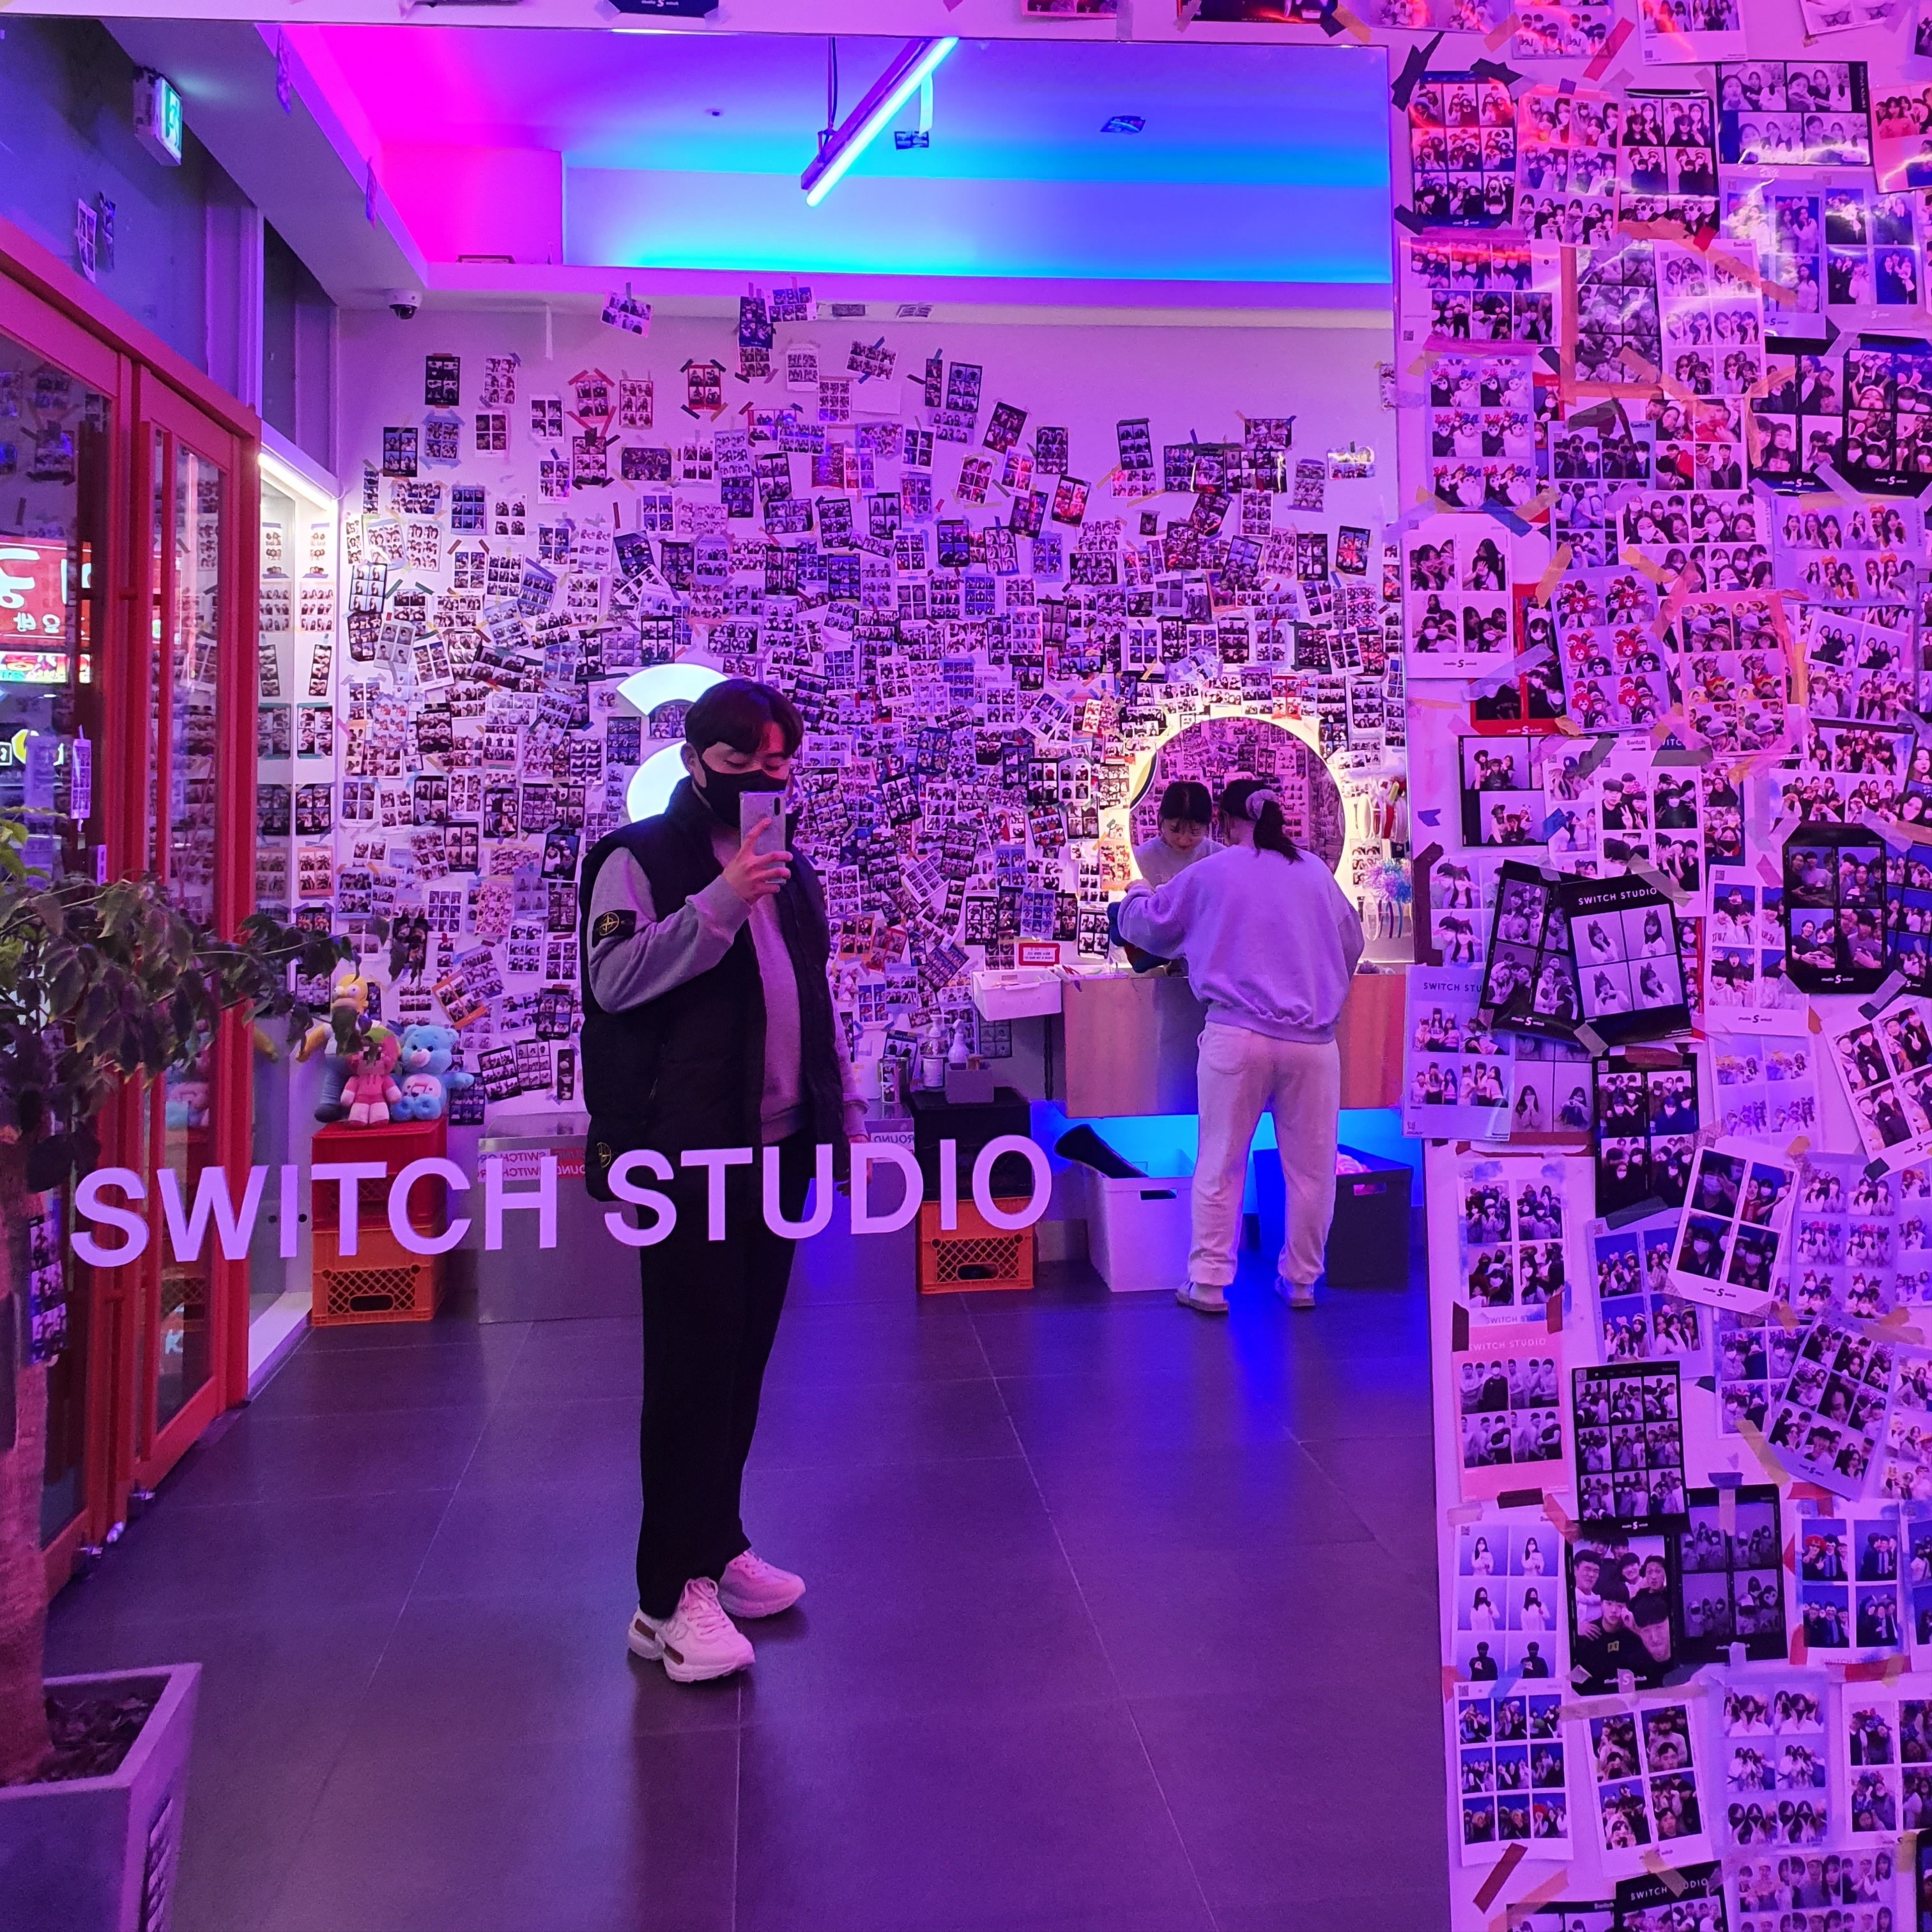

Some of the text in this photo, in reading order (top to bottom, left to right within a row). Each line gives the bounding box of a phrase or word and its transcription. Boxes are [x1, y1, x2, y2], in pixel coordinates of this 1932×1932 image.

[1578, 887, 1657, 905] SWITCH STUDIO
[1423, 982, 1482, 992] SWITCH STU
[70, 1134, 1053, 1268] SWITCH STUDIO
[1510, 1338, 1546, 1348] STUDIO
[1630, 1878, 1708, 1901] SWITCH UDIO
